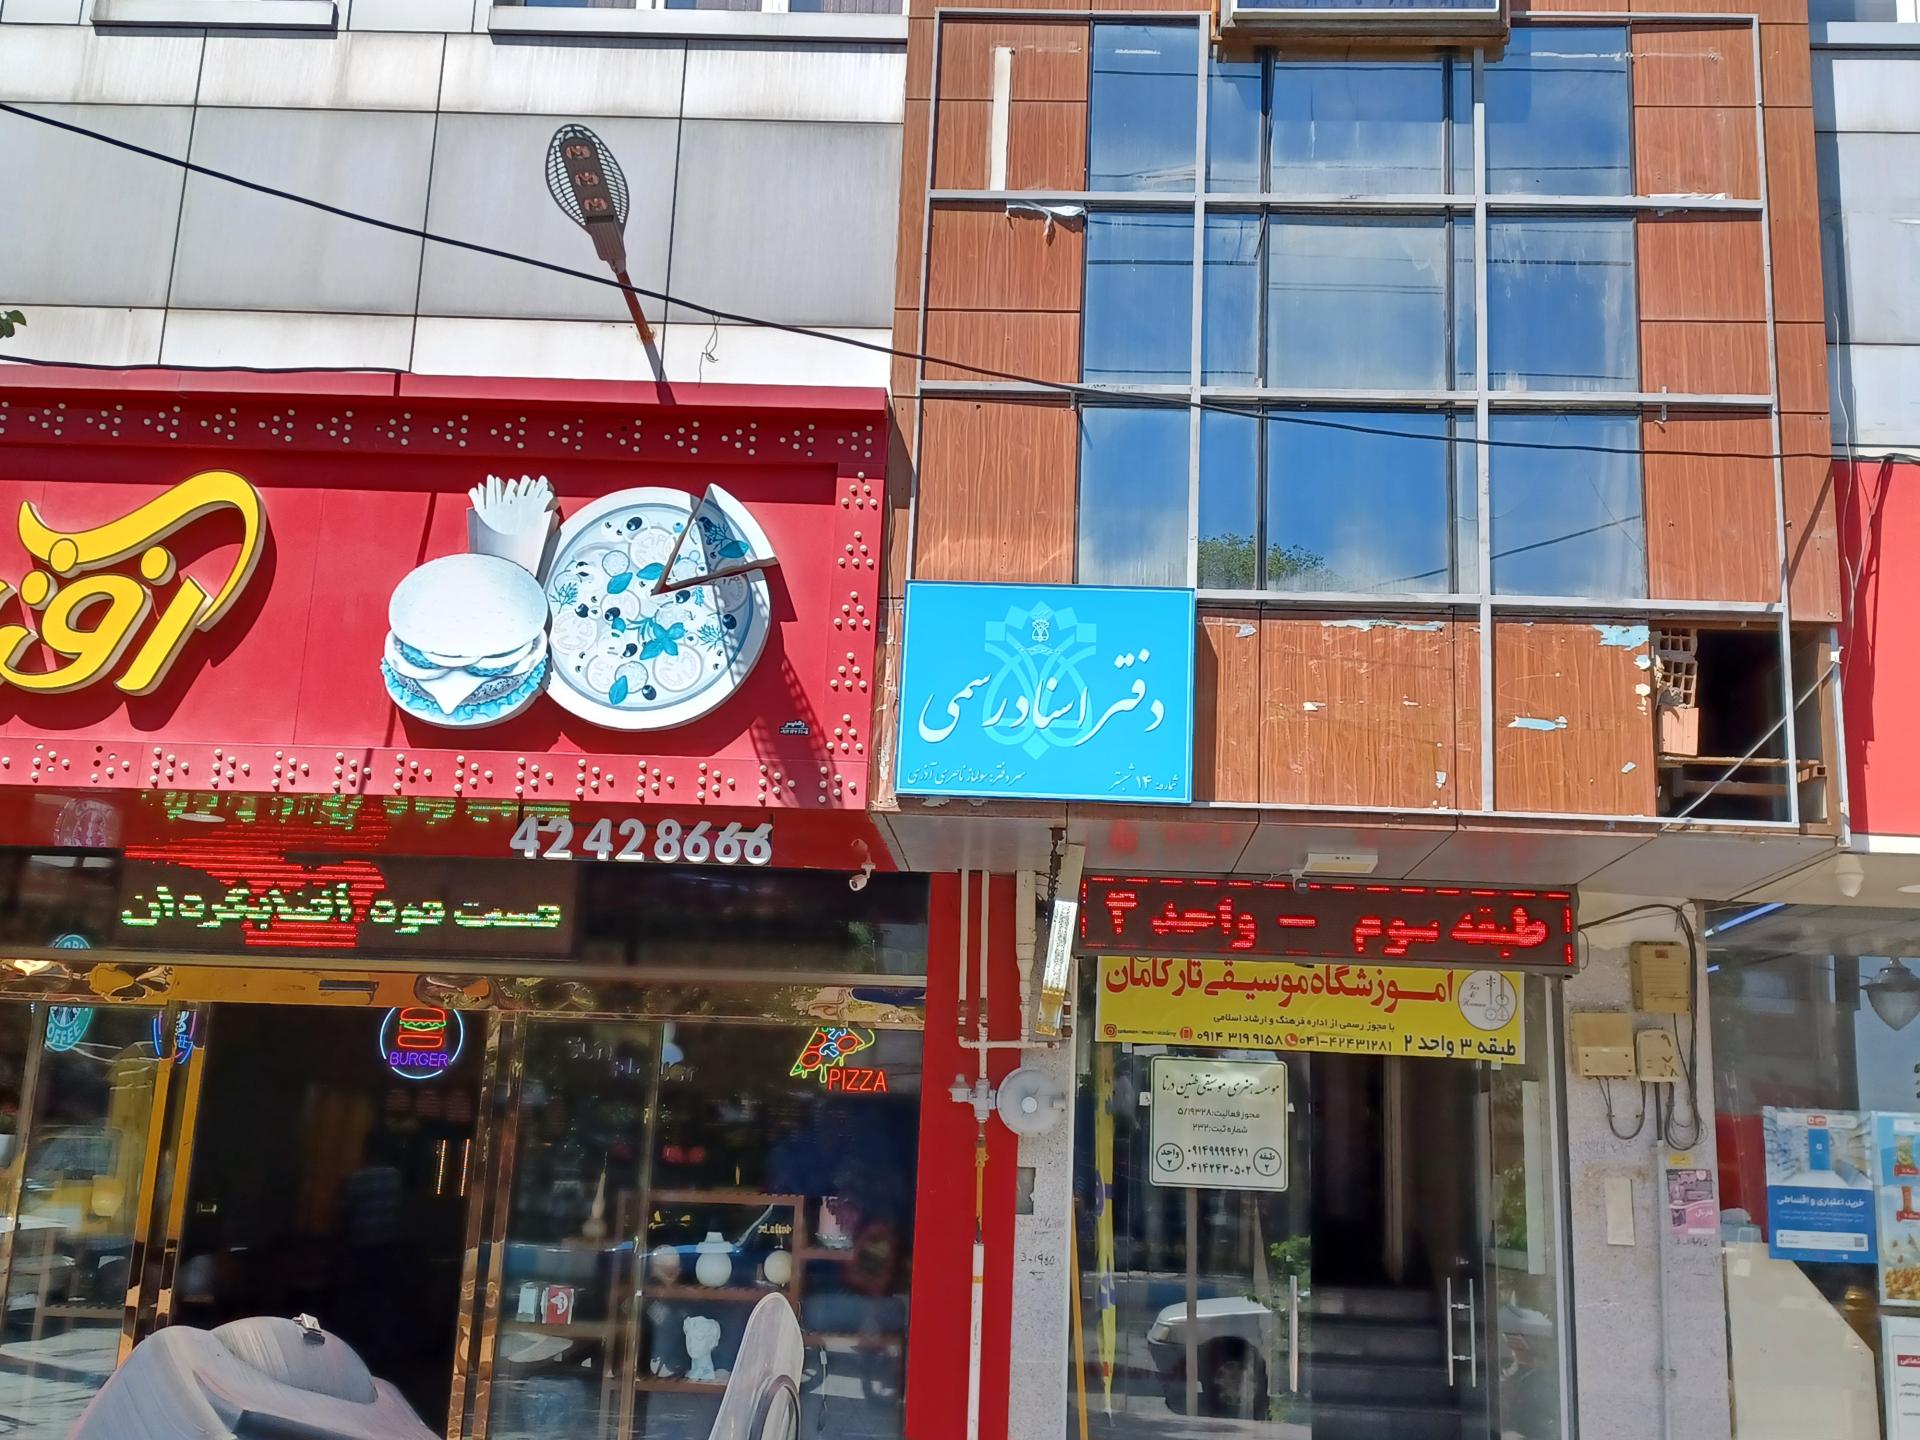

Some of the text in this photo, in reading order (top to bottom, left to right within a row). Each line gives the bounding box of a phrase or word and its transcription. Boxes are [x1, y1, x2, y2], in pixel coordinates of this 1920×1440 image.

[918, 648, 1165, 747] دفتر اسناد رسمی
[907, 761, 938, 784] آذری
[1108, 763, 1136, 792] شبستر
[1136, 775, 1152, 790] ۱۴
[1151, 898, 1257, 951] واحد
[1353, 915, 1439, 957] سوم
[1451, 904, 1548, 959] طبقه
[1204, 959, 1309, 1008] موسیقی
[1275, 1016, 1305, 1027] فرهنگ
[1307, 1018, 1328, 1028] اداره
[1331, 1018, 1338, 1028] از
[1339, 1021, 1364, 1031] رسمی
[1366, 1022, 1387, 1032] مجوز
[1388, 1023, 1395, 1031] با
[1403, 1034, 1516, 1061] طبقه ۳ واحد ۲
[389, 1051, 449, 1068] BURGER
[828, 1068, 888, 1092] PIZZA
[1160, 1148, 1180, 1159] واحد
[1259, 1153, 1276, 1162] طبقه
[1167, 1159, 1172, 1168] ۲
[1777, 1195, 1809, 1205] اقساطی
[1845, 1198, 1865, 1209] خرید
